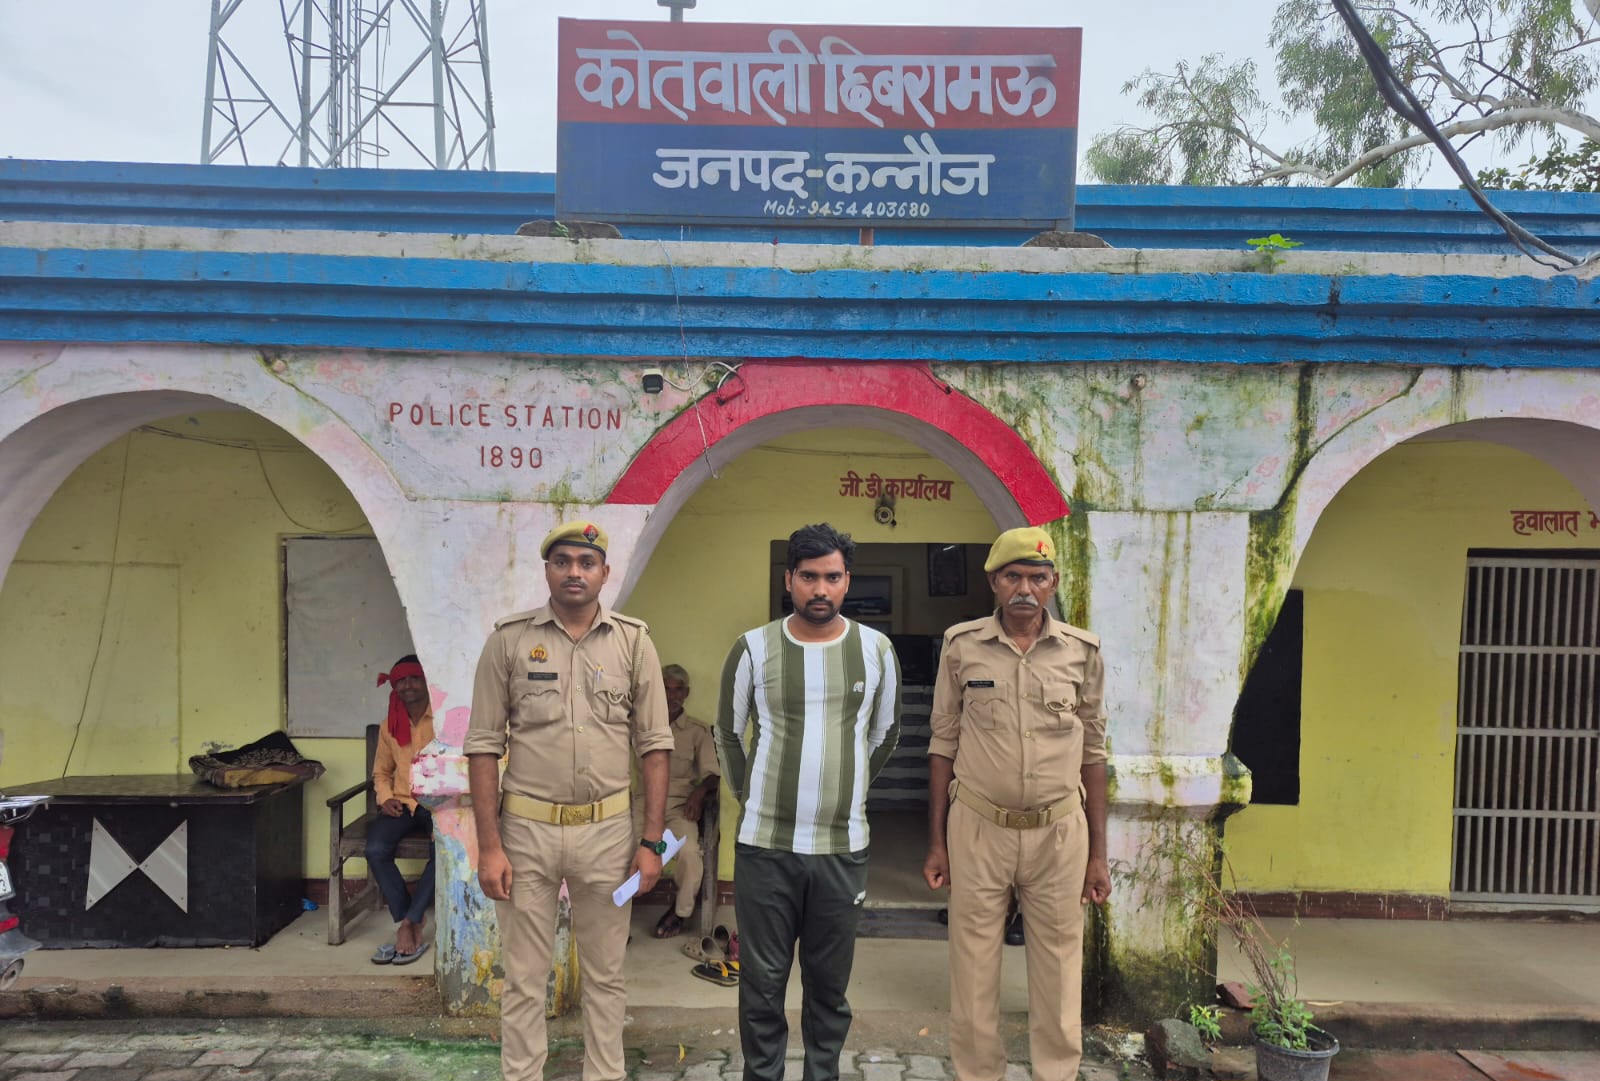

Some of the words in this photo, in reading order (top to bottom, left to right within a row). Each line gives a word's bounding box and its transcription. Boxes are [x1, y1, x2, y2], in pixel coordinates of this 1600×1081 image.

[575, 28, 817, 126] कोतवाली
[389, 402, 491, 427] POLICE
[504, 404, 622, 430] STATION
[480, 445, 543, 468] 1890
[884, 473, 955, 502] कार्यालय
[1510, 510, 1581, 538] हवालात
